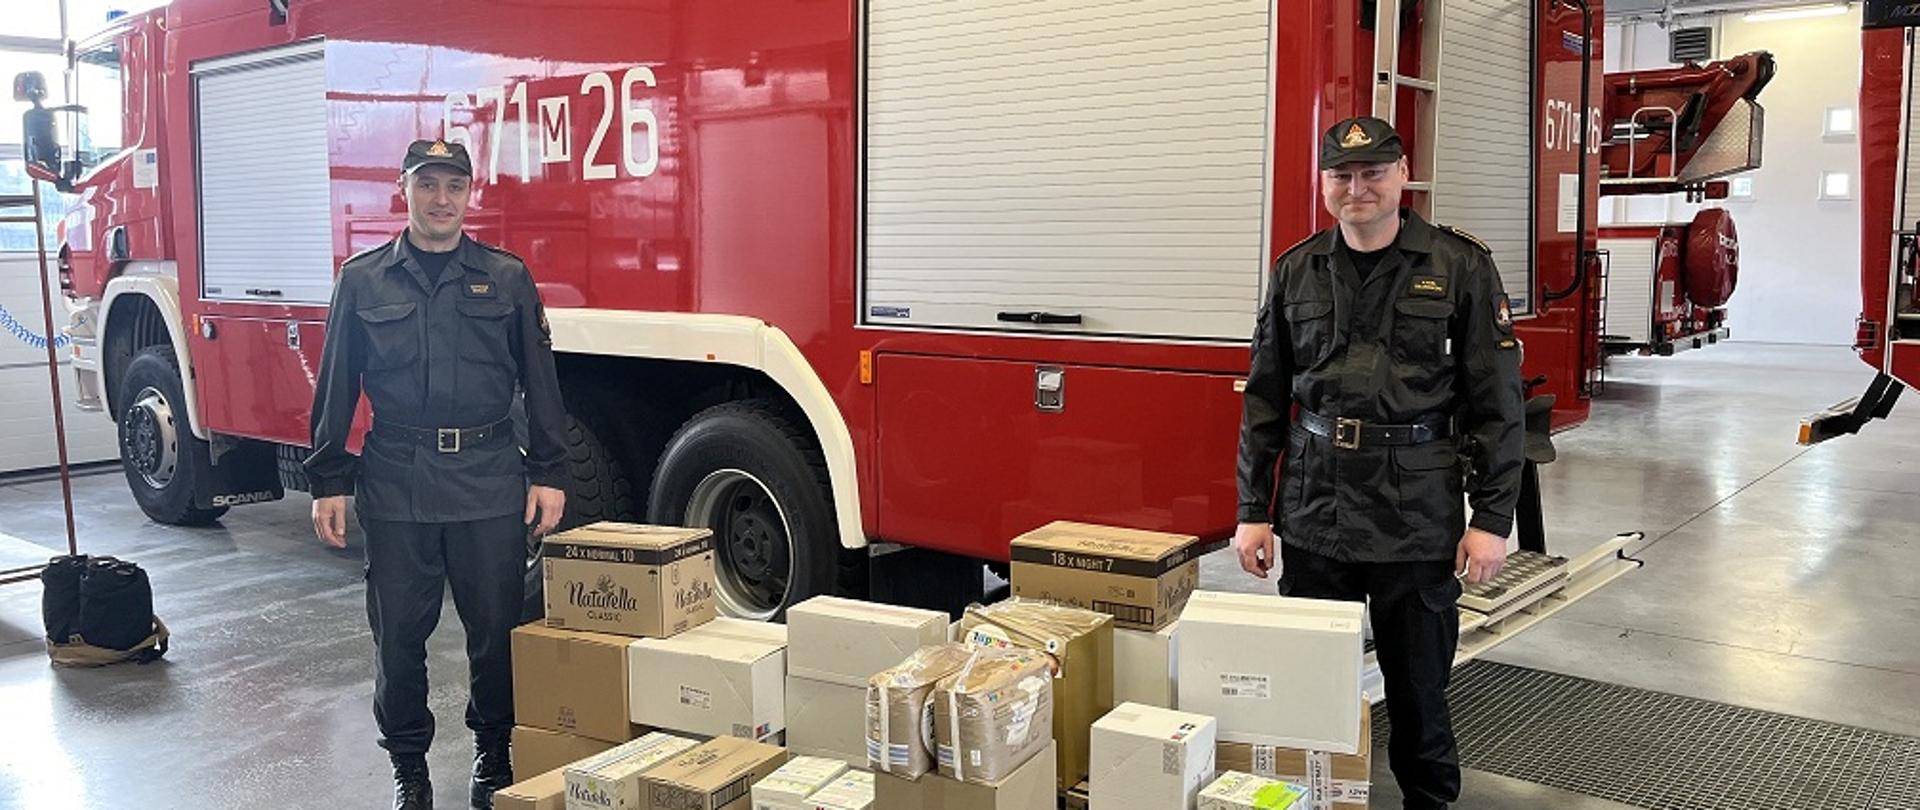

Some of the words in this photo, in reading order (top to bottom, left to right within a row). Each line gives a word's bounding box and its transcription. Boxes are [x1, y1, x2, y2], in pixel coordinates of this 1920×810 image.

[539, 97, 571, 162] M
[580, 66, 659, 180] 26
[1546, 99, 1572, 152] 671
[212, 490, 273, 507] SCANIA
[565, 545, 579, 559] 24
[621, 549, 635, 562] 10
[1051, 551, 1066, 566] 18
[1105, 558, 1114, 572] 7
[564, 580, 638, 611] Naturella
